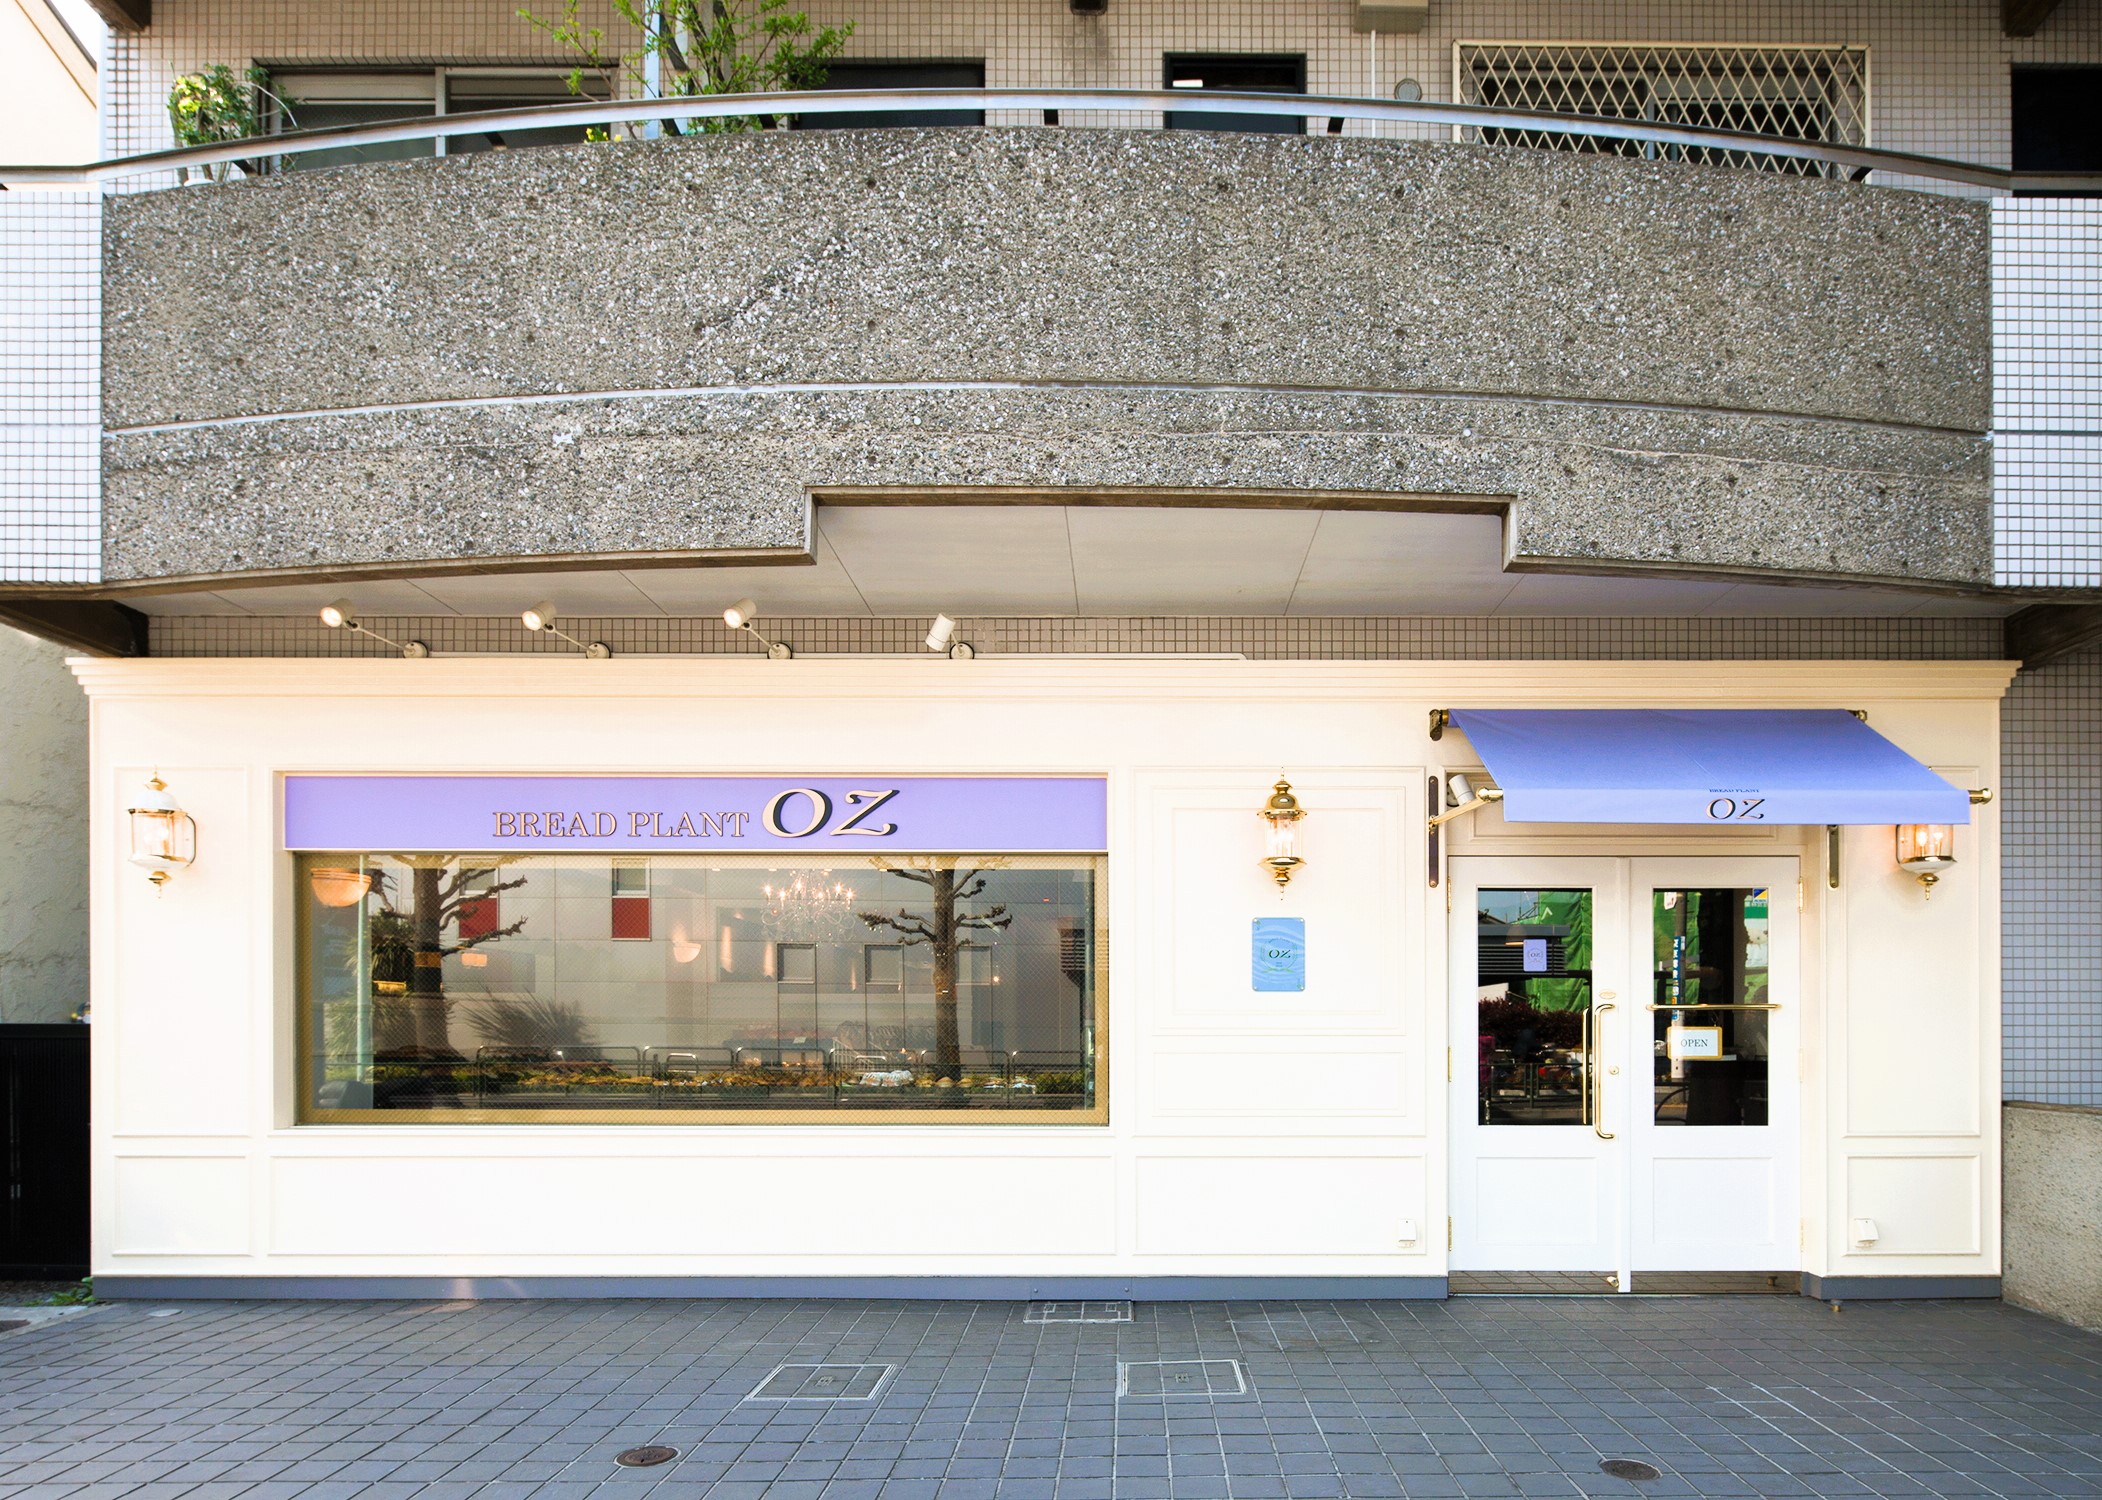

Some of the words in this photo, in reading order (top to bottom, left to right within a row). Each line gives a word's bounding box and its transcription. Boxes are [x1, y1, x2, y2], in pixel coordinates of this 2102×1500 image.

[493, 811, 617, 837] BREAD
[627, 811, 749, 837] PLANT
[761, 788, 900, 838] OZ
[1706, 797, 1765, 819] OZ
[1268, 949, 1291, 959] OZ
[1680, 1038, 1709, 1048] OPEN
